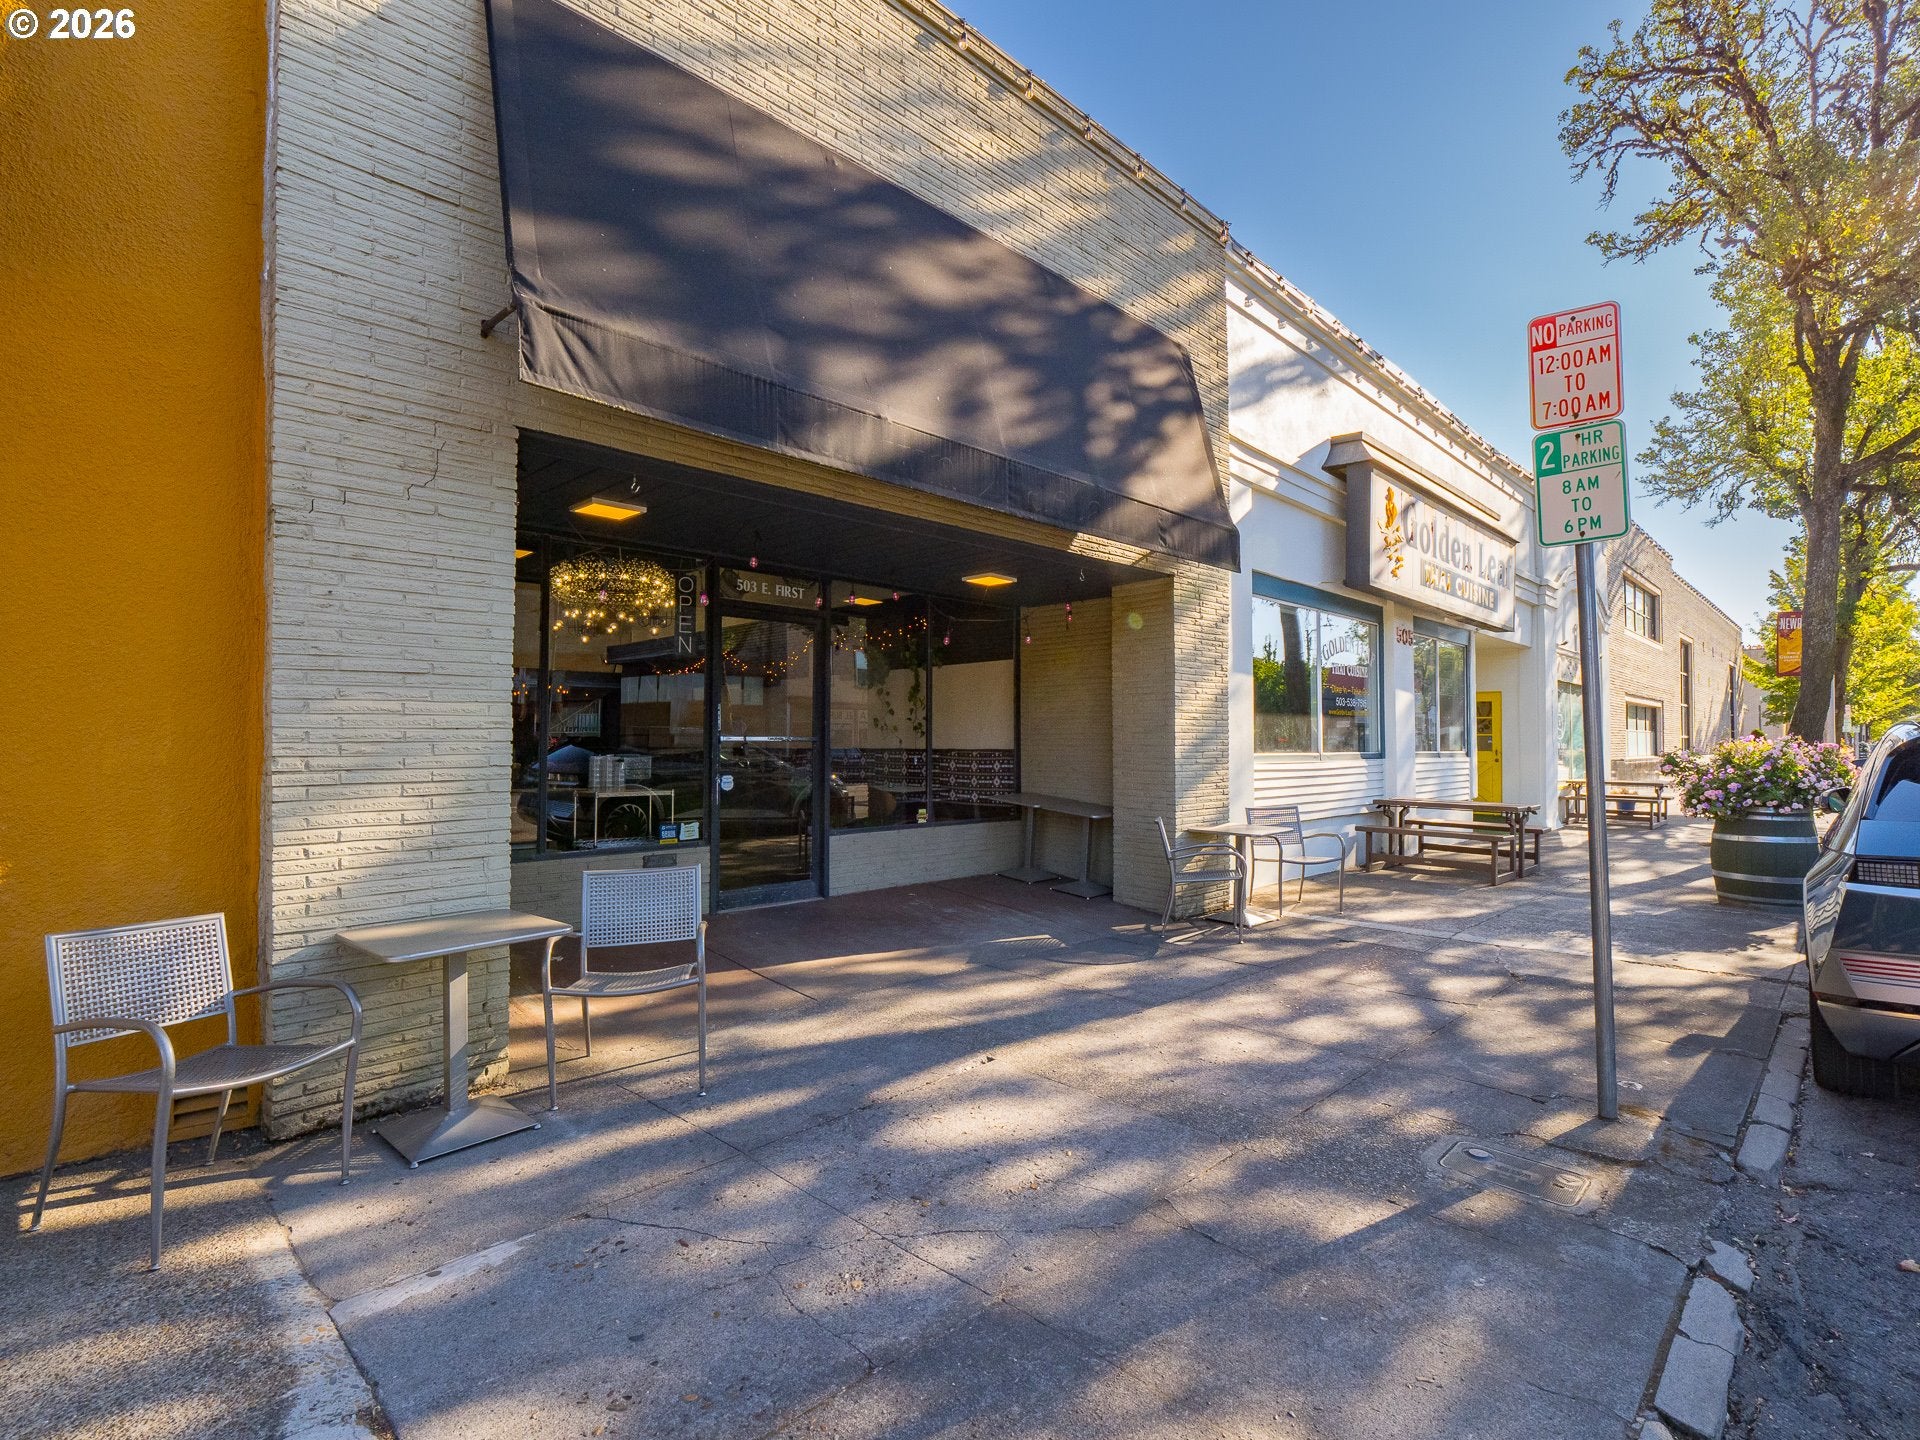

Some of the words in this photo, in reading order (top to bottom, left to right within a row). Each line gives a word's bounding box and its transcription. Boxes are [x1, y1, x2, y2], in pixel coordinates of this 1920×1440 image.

[1531, 322, 1555, 347] NO
[1559, 313, 1613, 338] PARKING
[1564, 372, 1586, 393] TO
[1540, 441, 1556, 470] 2
[1581, 429, 1604, 446] HR
[1563, 445, 1620, 469] PARKING
[1571, 496, 1592, 513] TO
[1402, 502, 1472, 574] Golden
[1478, 541, 1513, 590] Leaf
[736, 578, 757, 593] 503
[761, 582, 771, 595] E.
[775, 584, 805, 600] FIRST
[1424, 563, 1452, 593] THAI
[1456, 577, 1496, 609] CUISINE
[678, 576, 694, 654] OPEN
[1396, 626, 1413, 647] 505
